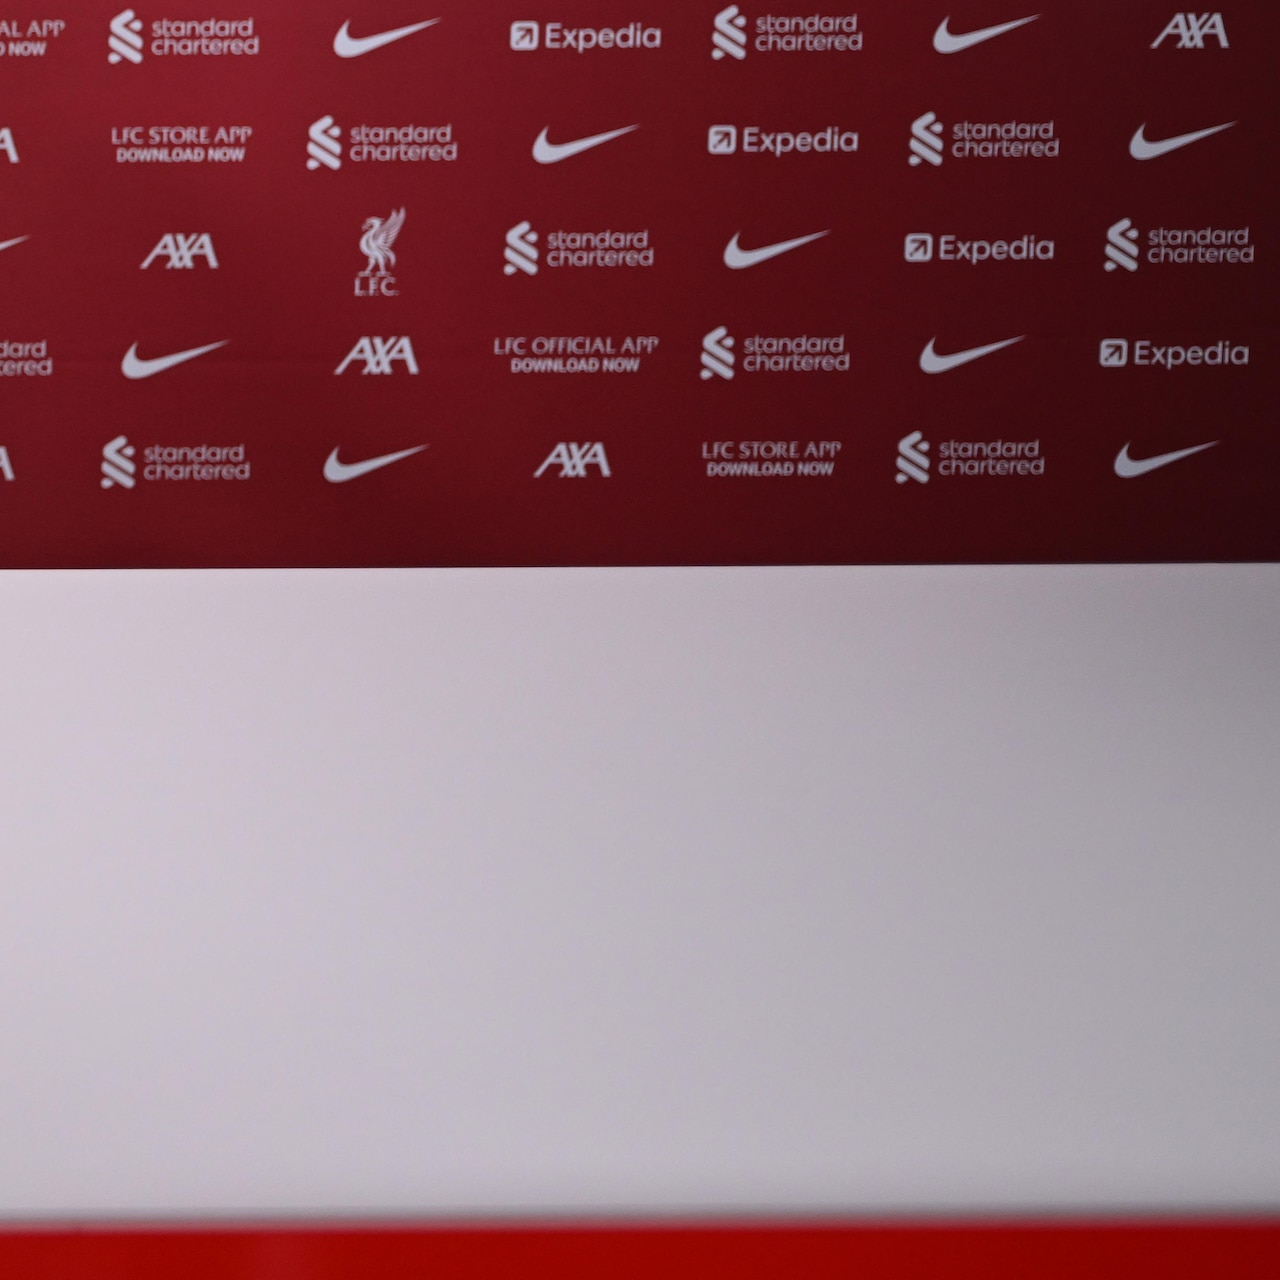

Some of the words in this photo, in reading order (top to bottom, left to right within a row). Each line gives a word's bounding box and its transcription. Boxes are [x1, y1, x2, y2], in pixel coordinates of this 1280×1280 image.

[26, 19, 66, 38] APP
[151, 17, 254, 37] standard
[1150, 12, 1230, 49] AXA
[150, 36, 260, 56] chartered
[544, 22, 662, 54] Expedia
[7, 40, 47, 57] NOW
[547, 229, 649, 249] standard
[546, 248, 655, 268] chartered
[1133, 340, 1250, 370] Expedia
[143, 443, 245, 463] standard
[701, 441, 734, 459] LFC
[739, 440, 799, 459] STORE
[804, 440, 842, 458] APP
[939, 439, 1039, 458] standard
[533, 441, 611, 478] AXA
[706, 461, 795, 477] DOWNLOAD
[796, 460, 835, 477] NOW
[937, 457, 1045, 476] chartered
[143, 462, 251, 481] chartered
